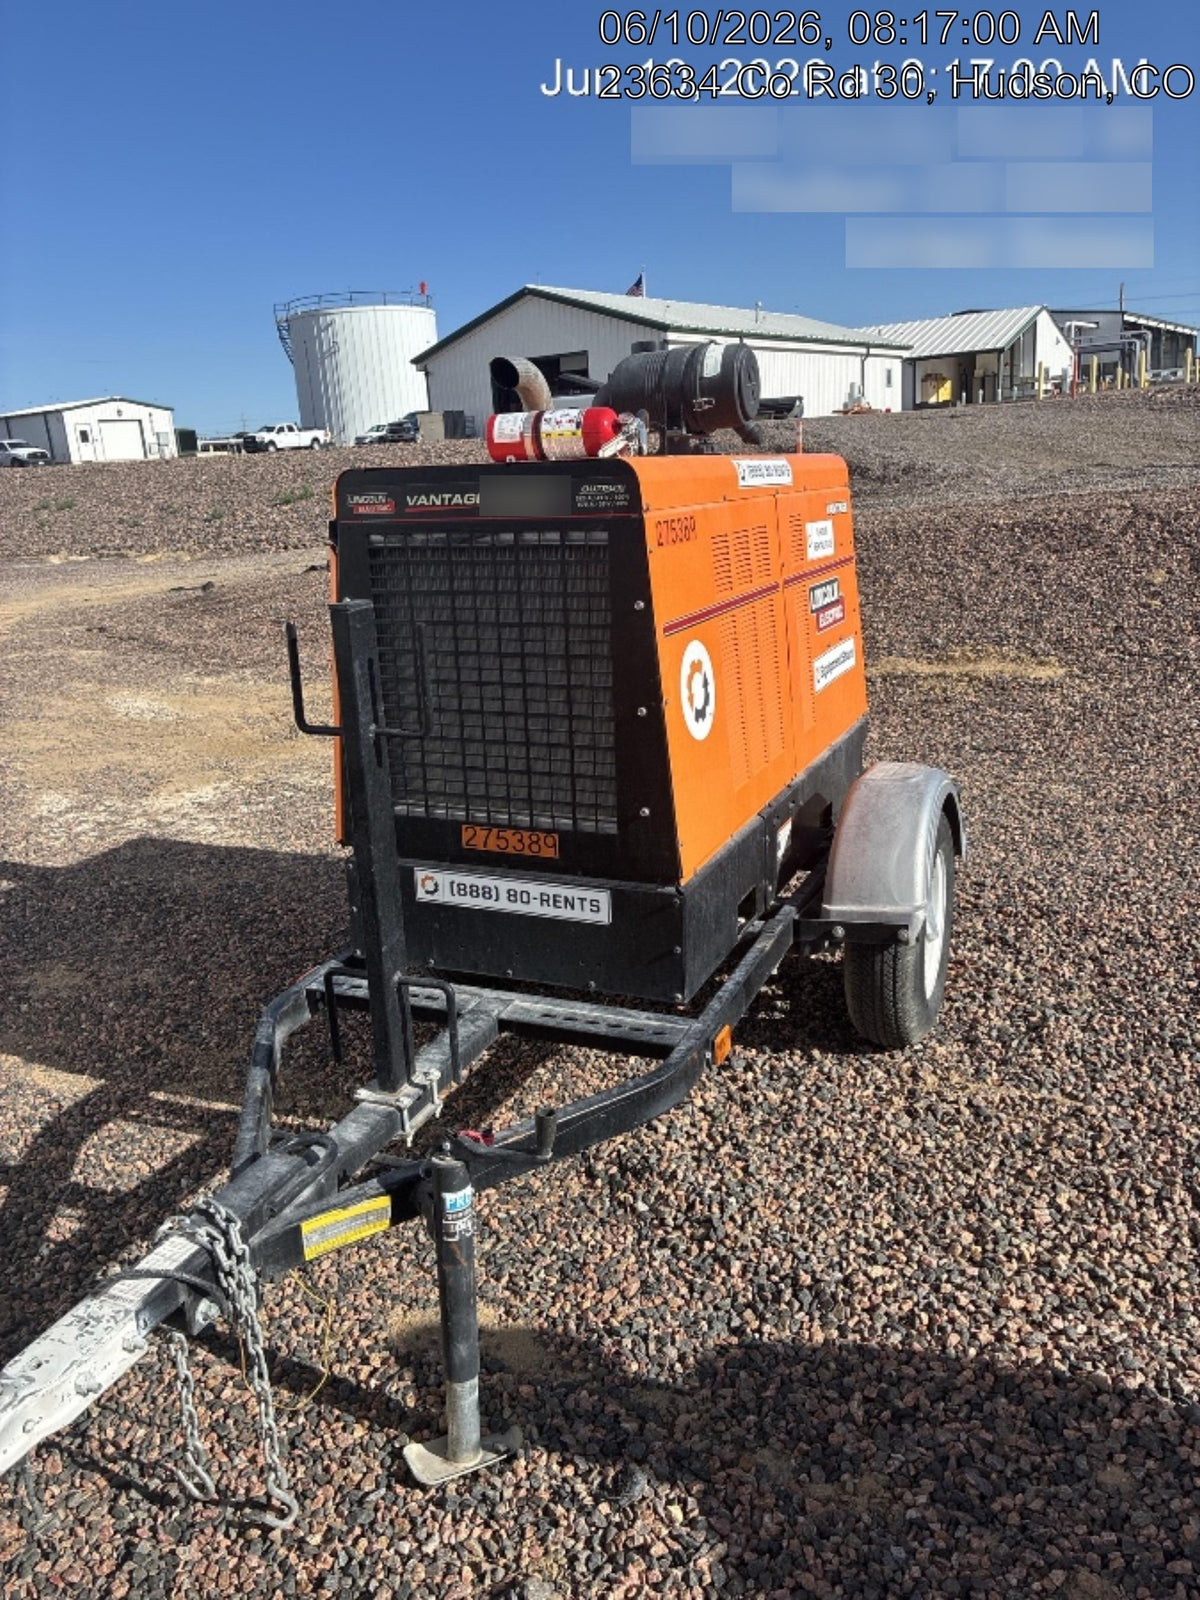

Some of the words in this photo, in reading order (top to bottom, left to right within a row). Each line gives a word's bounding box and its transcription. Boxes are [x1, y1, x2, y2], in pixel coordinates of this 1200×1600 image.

[464, 826, 557, 857] 275389
[450, 880, 499, 901] (888)
[506, 888, 601, 914] 80-RENTS
